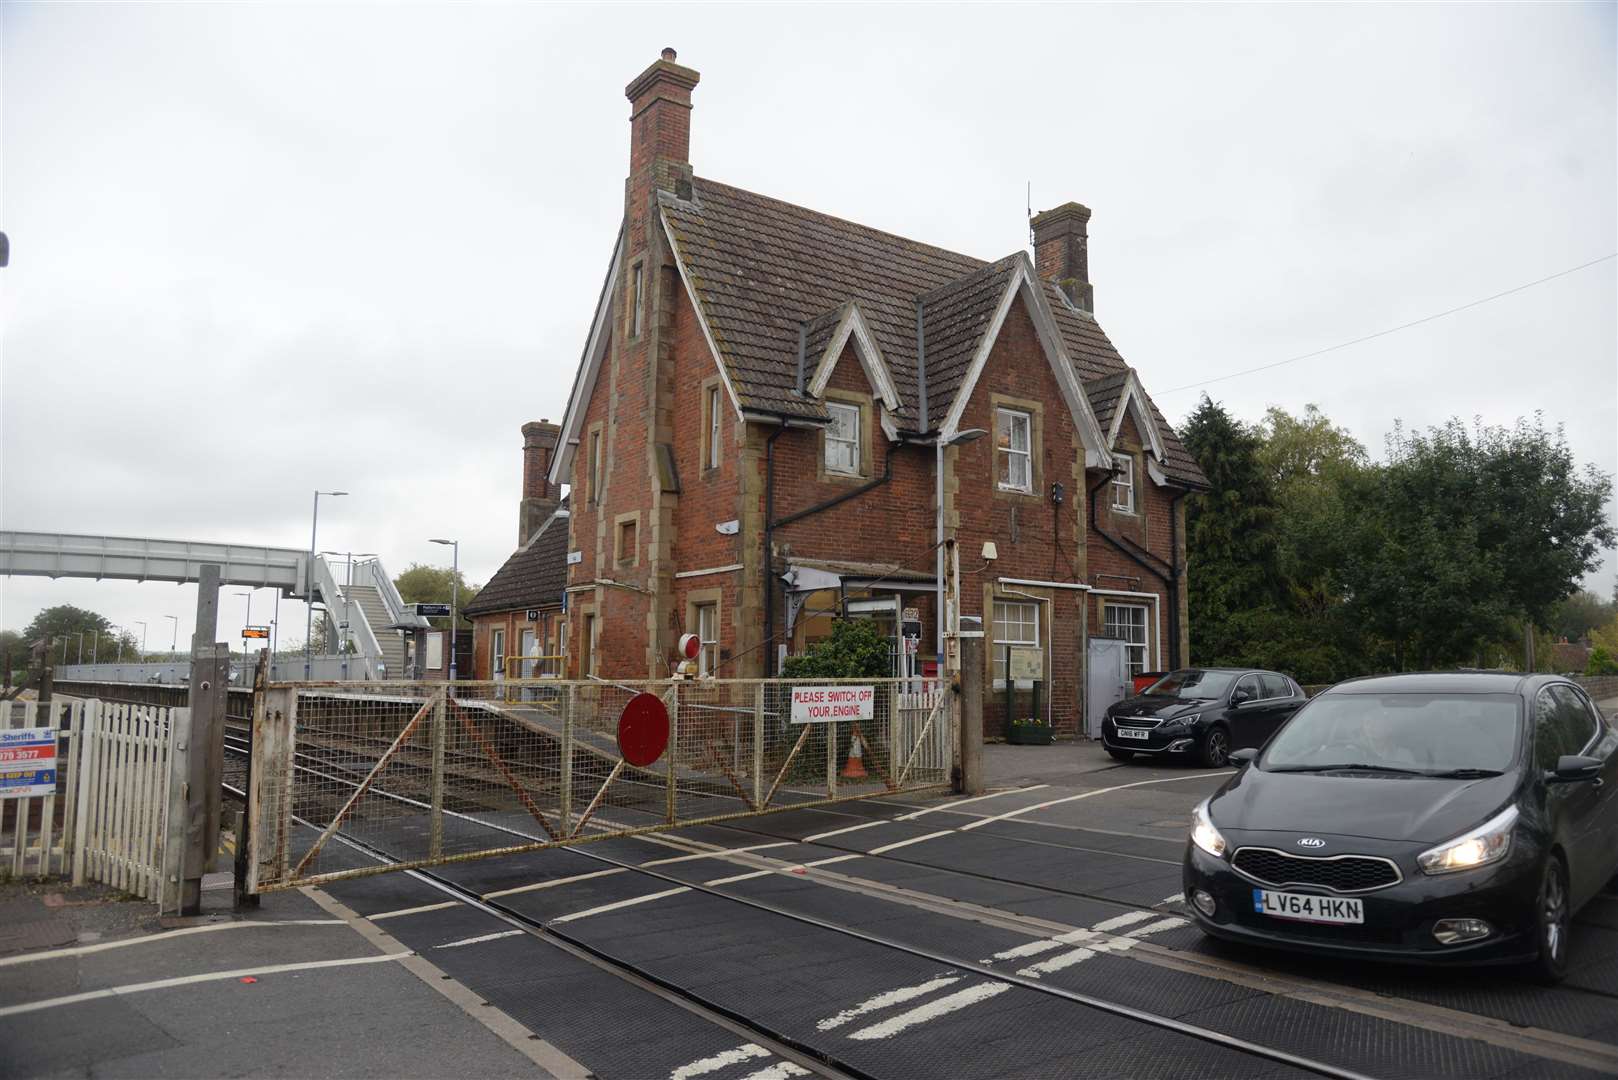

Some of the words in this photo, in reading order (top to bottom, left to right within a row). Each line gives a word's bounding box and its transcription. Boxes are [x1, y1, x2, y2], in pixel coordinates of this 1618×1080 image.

[794, 691, 824, 703] PLEASE
[827, 690, 856, 702] SWITCH
[858, 689, 872, 700] OFF
[808, 706, 830, 718] YOUR
[833, 704, 860, 716] ENGINE
[1301, 838, 1322, 846] KIA
[1266, 893, 1314, 914] LV64
[1320, 900, 1360, 919] HKN
